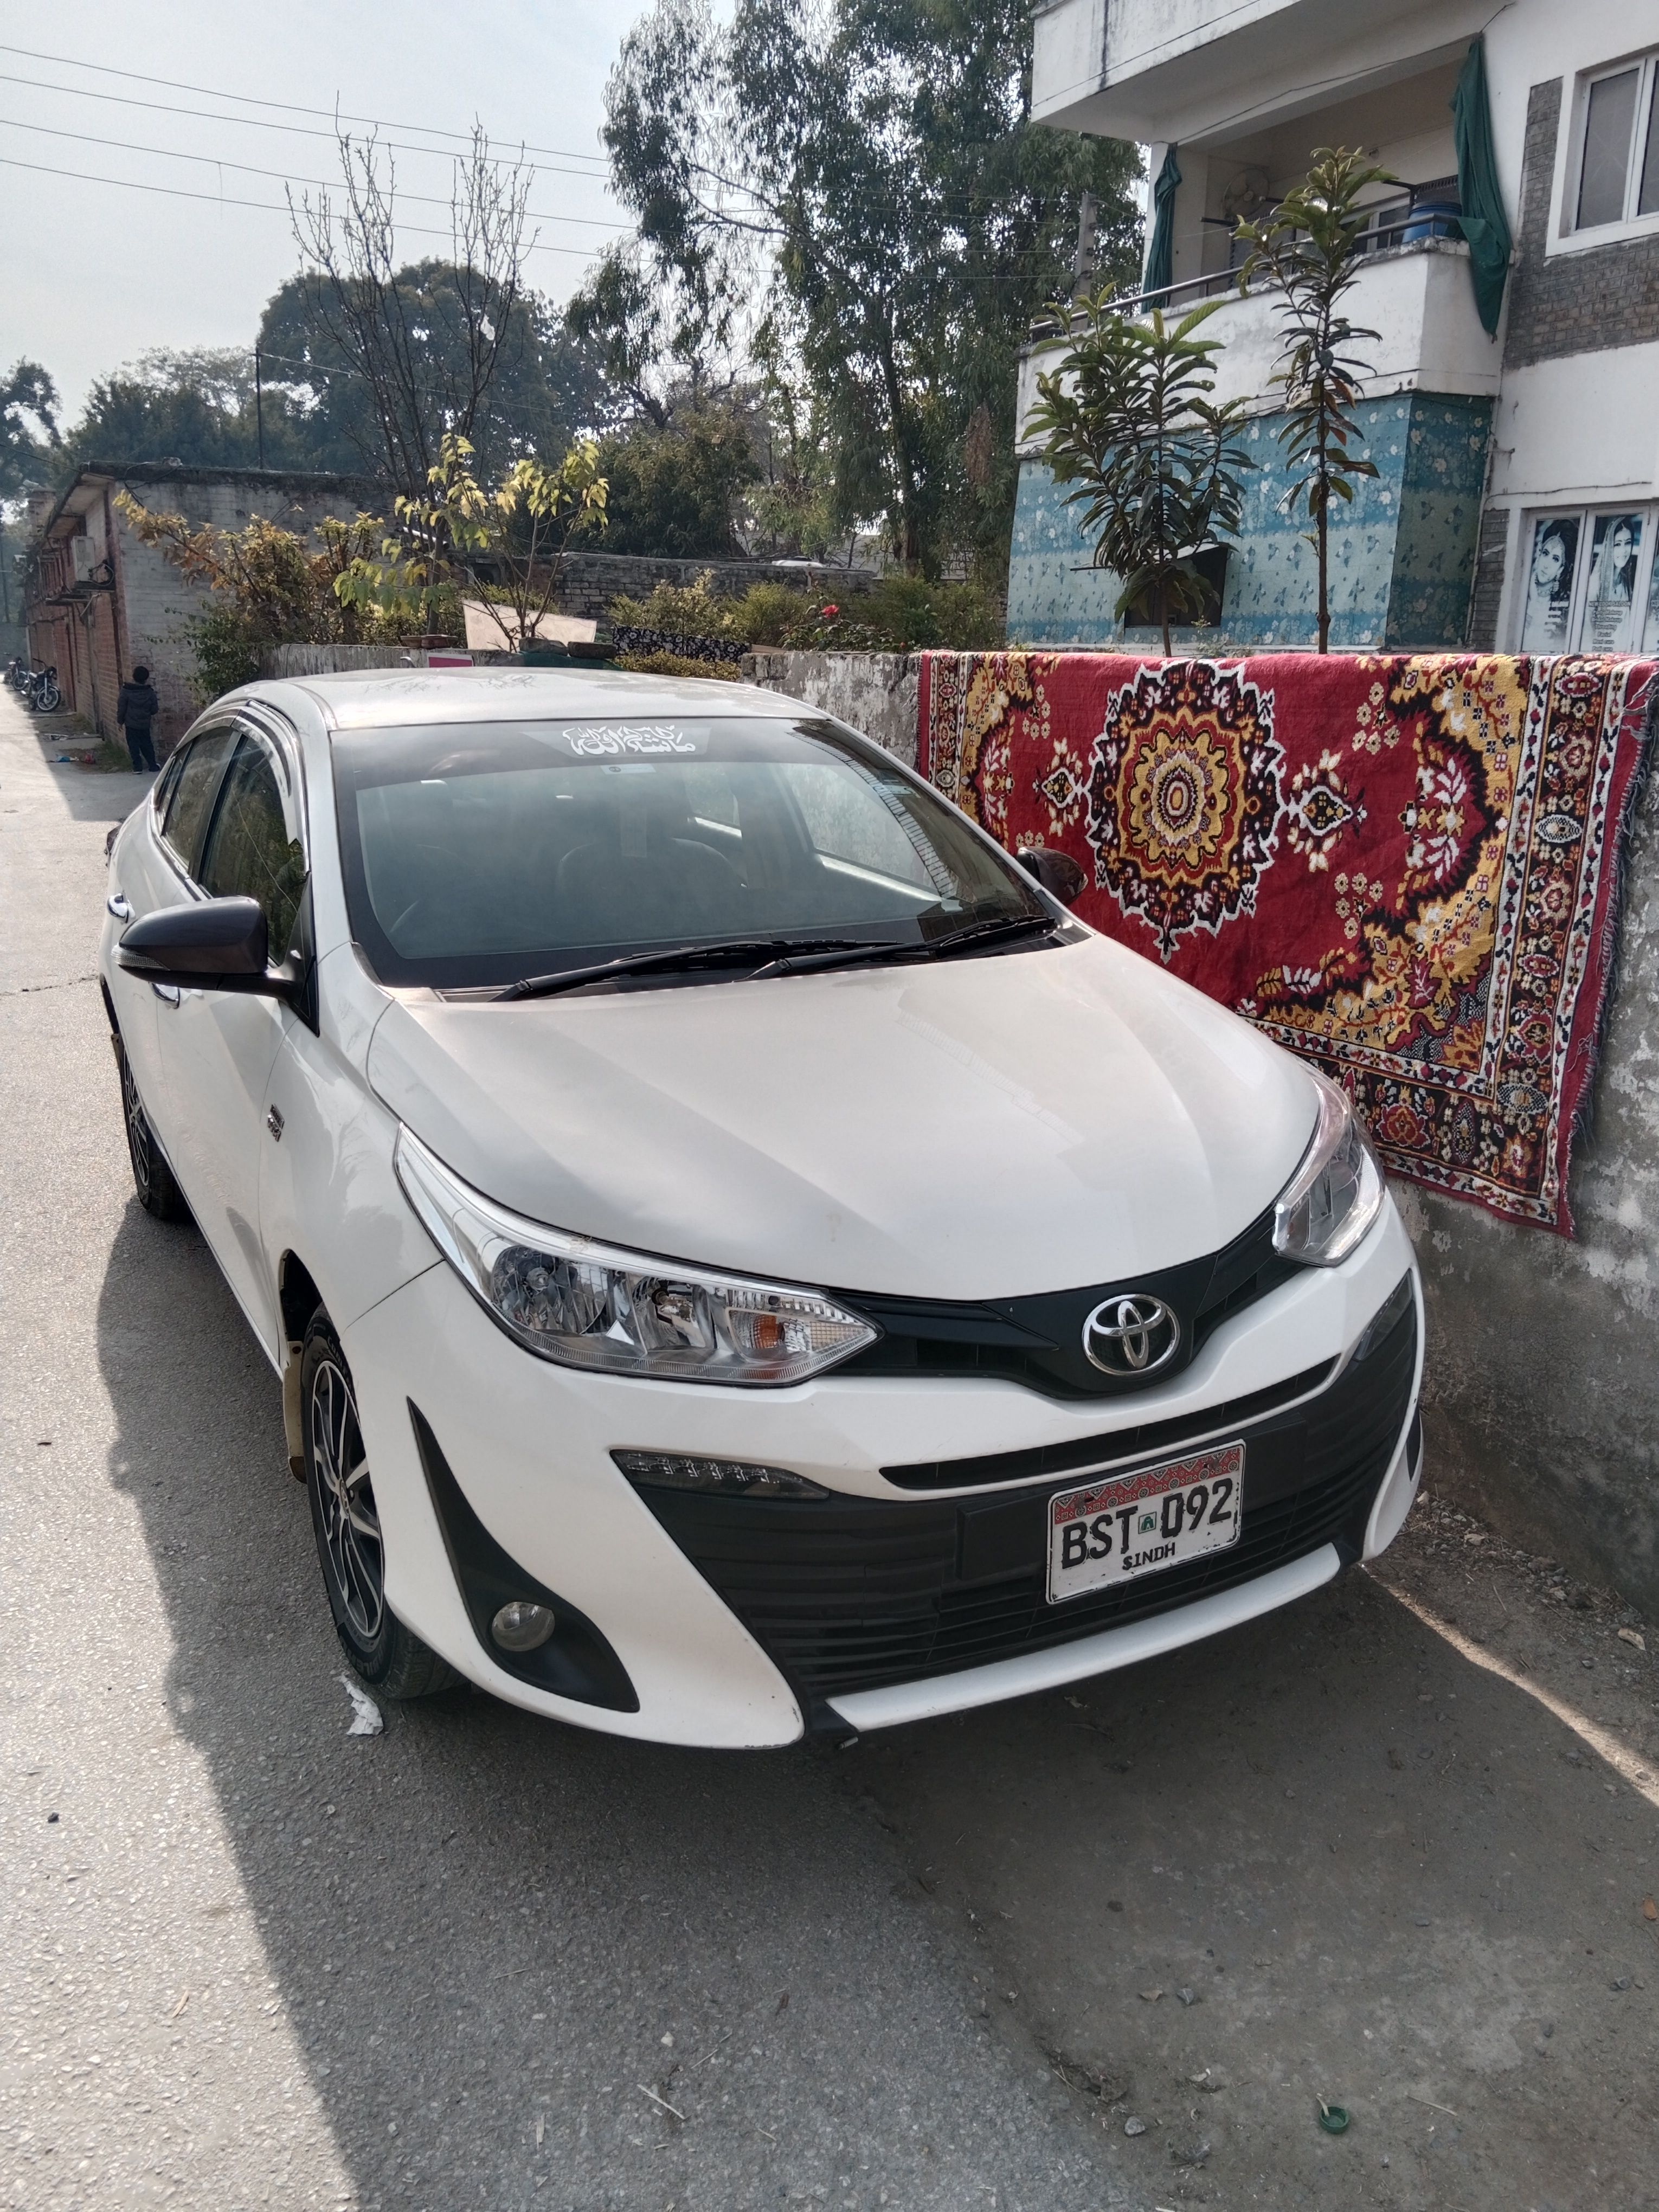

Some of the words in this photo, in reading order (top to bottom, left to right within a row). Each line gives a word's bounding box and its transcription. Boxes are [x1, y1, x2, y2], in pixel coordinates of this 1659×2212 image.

[1062, 1505, 1138, 1570] BST
[1160, 1477, 1233, 1539] 092
[1122, 1542, 1176, 1571] SINDH
